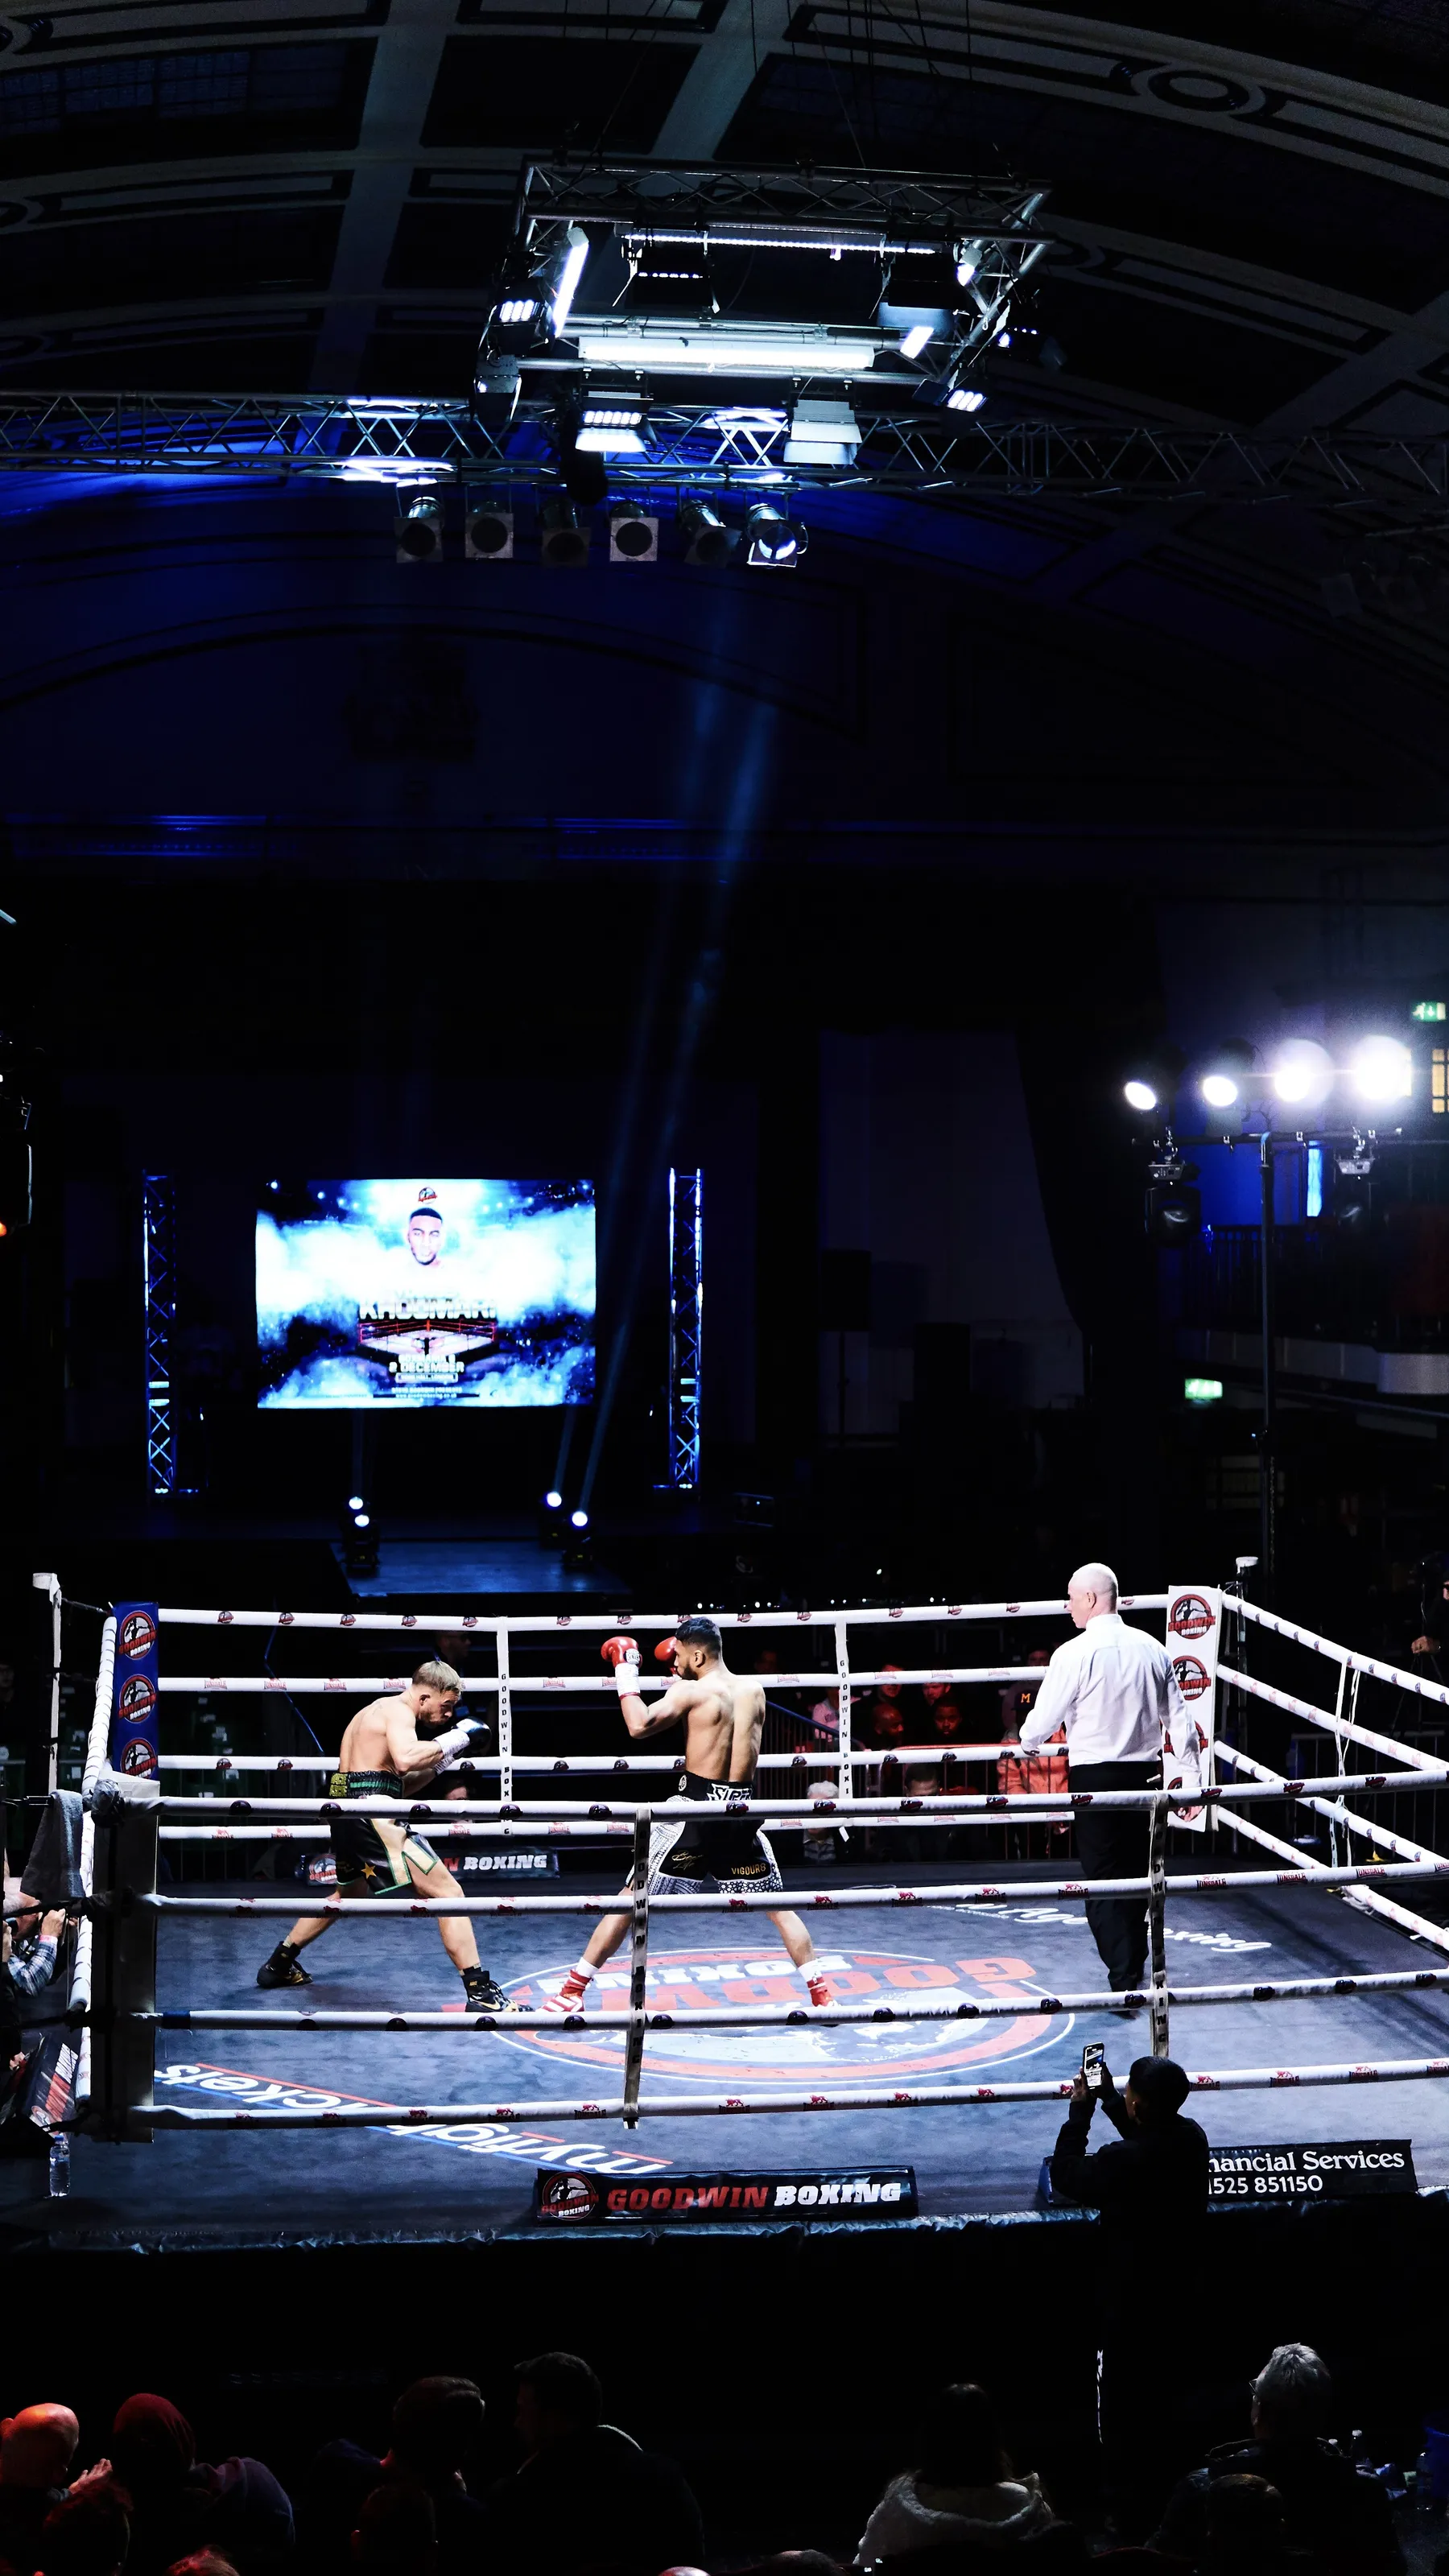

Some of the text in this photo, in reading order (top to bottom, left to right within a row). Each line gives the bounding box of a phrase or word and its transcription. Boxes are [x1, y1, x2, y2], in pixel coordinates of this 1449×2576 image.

[1168, 1615, 1216, 1632] GOODWIN
[1181, 1626, 1207, 1636] BOXING
[119, 1629, 157, 1655] GOODWIN
[130, 1641, 151, 1657] BOXING
[1179, 1677, 1211, 1690] ODWIN
[1182, 1687, 1202, 1696] OXING
[840, 1660, 848, 1737] GOODWIN
[1021, 1693, 1031, 1703] M
[130, 1705, 151, 1720] BOXING
[464, 1855, 547, 1872] BOXING
[1277, 1872, 1307, 1885] LONSDALE
[1356, 1866, 1386, 1878] LONSDALE
[1208, 2149, 1406, 2173] nancial Services
[1208, 2174, 1323, 2195] 1525 851150
[541, 2192, 600, 2213] GOODWIN
[607, 2182, 902, 2211] GOODWIN BOXING
[558, 2204, 590, 2218] BOXING
